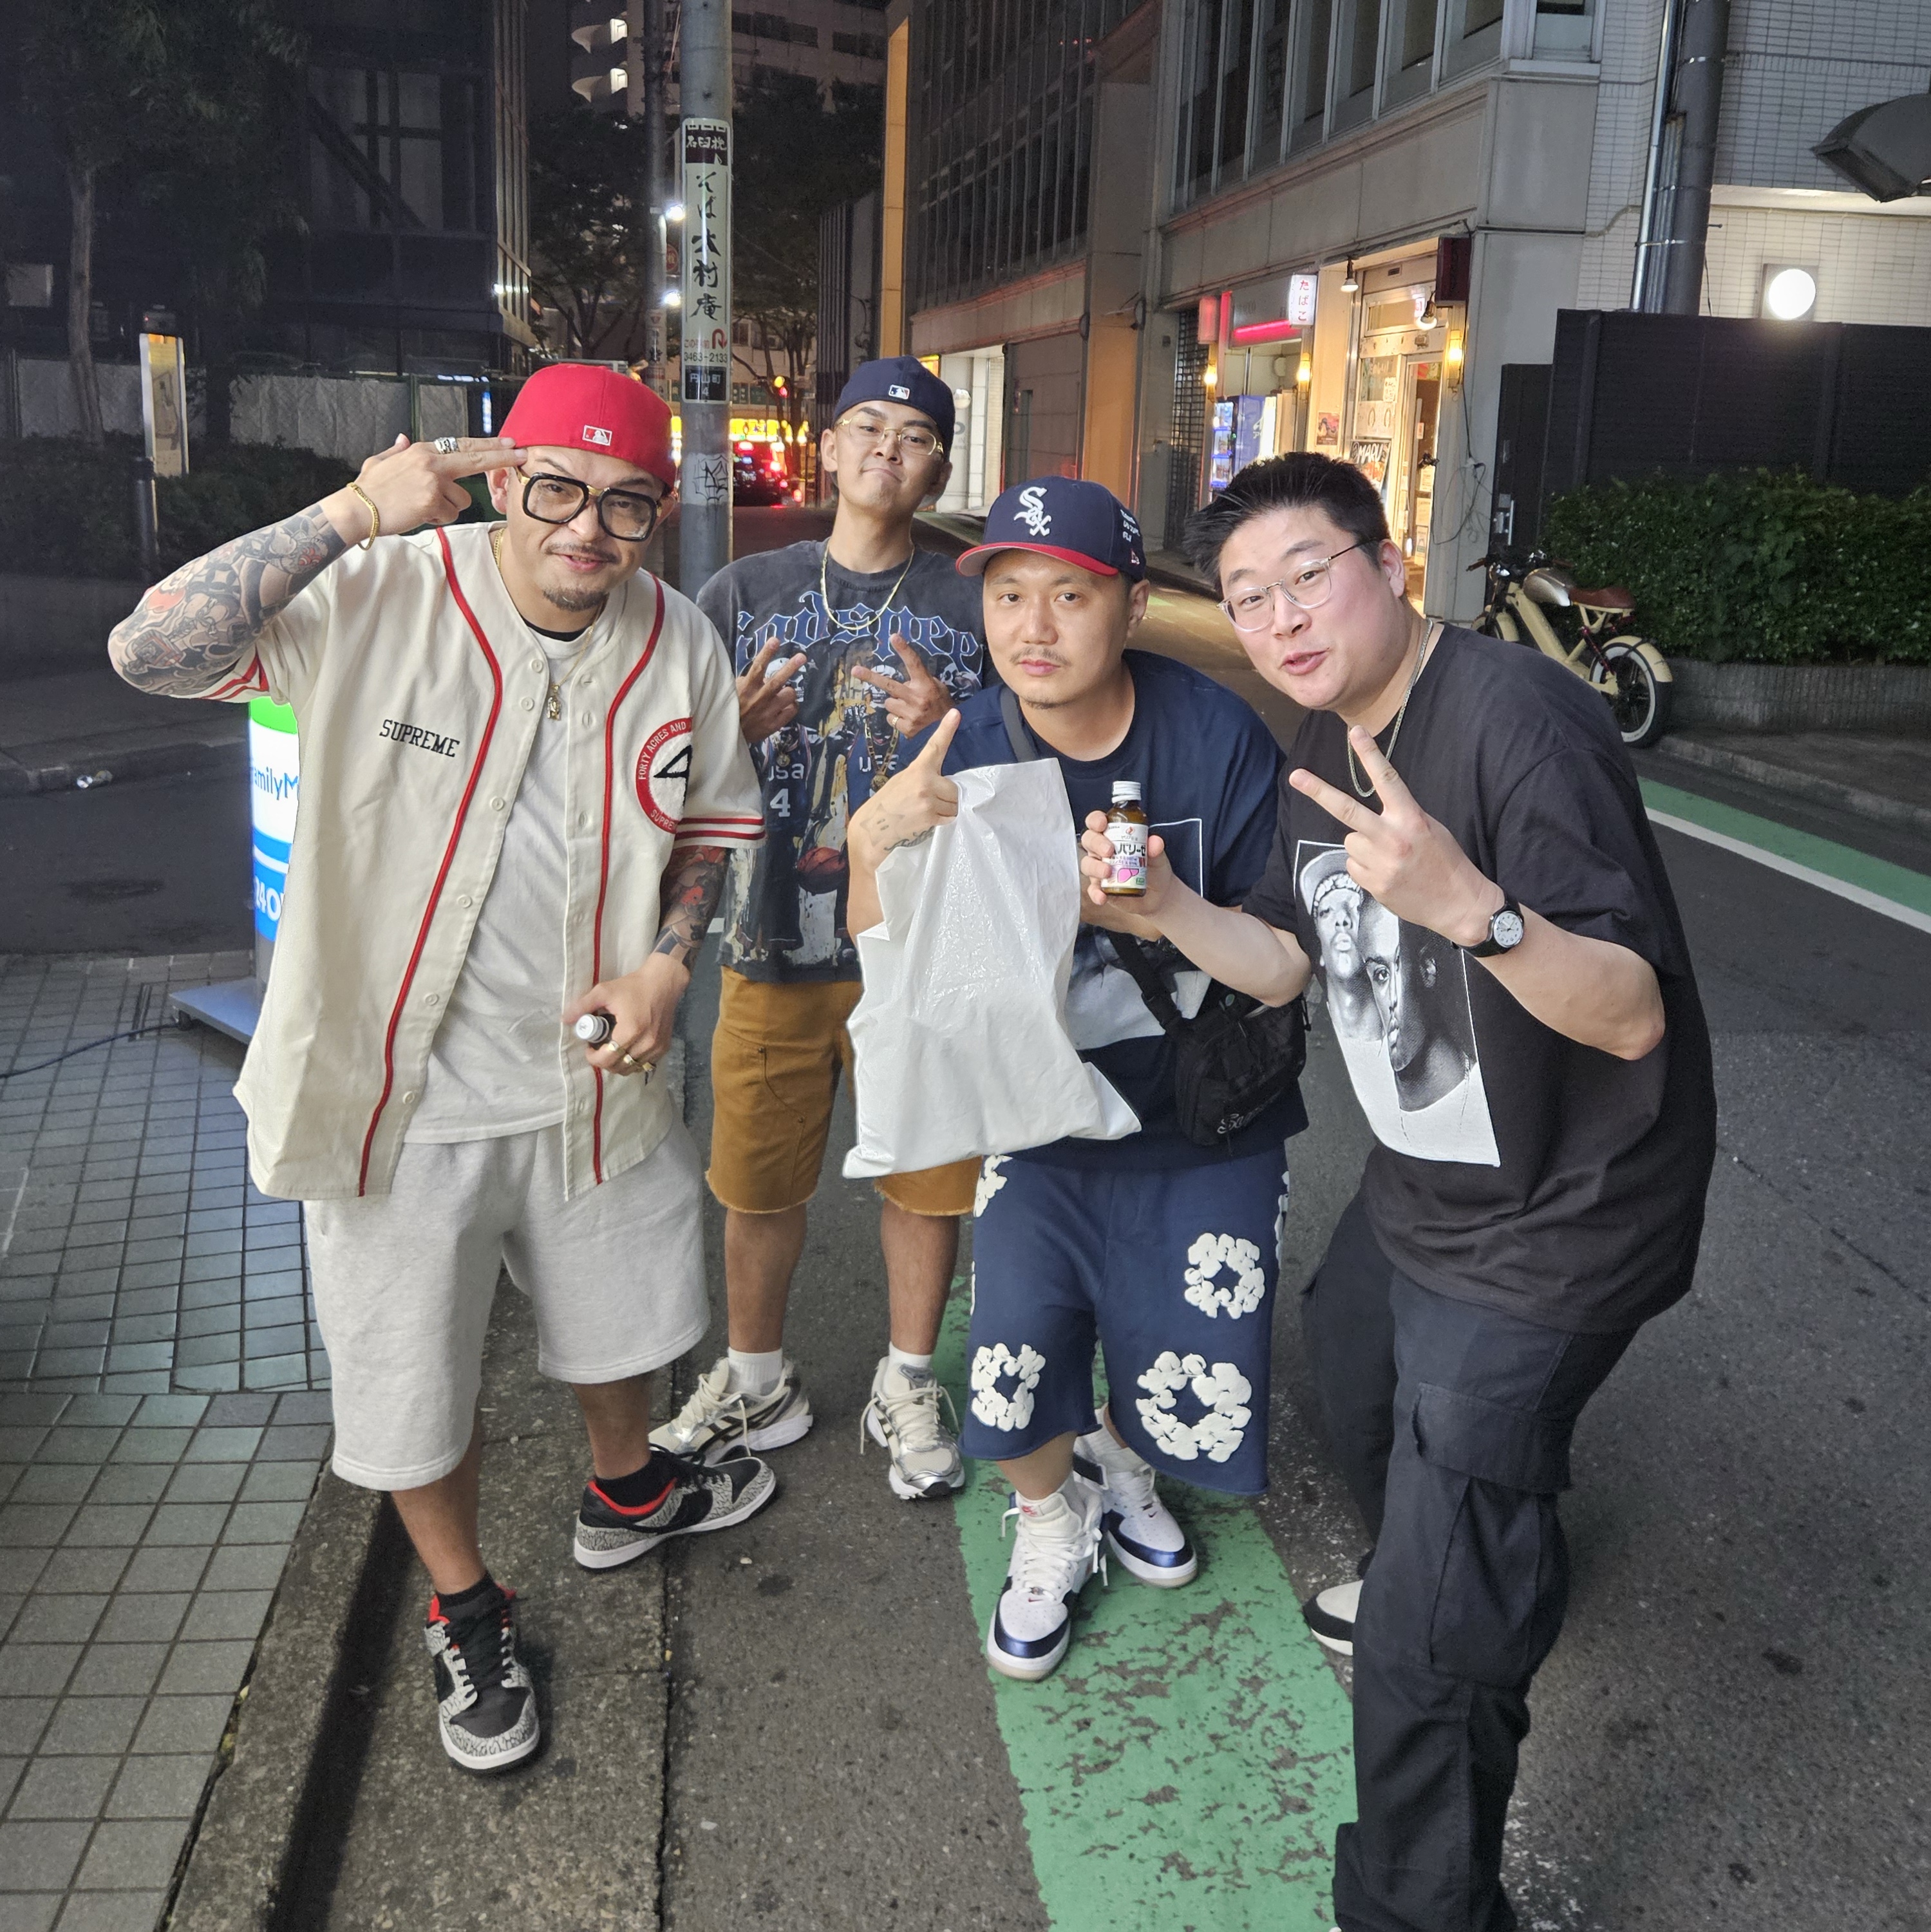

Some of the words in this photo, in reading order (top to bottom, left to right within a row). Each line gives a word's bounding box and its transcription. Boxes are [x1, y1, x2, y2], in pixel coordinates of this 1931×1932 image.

[1297, 279, 1310, 321] たばこ
[684, 352, 728, 363] 3463-2133
[690, 373, 721, 384] 円山町
[379, 718, 461, 758] SUPREME
[638, 752, 651, 780] FORTY
[646, 728, 669, 755] ACRES
[670, 720, 687, 733] AND
[769, 787, 791, 818] 4
[650, 809, 677, 831] SUPRE
